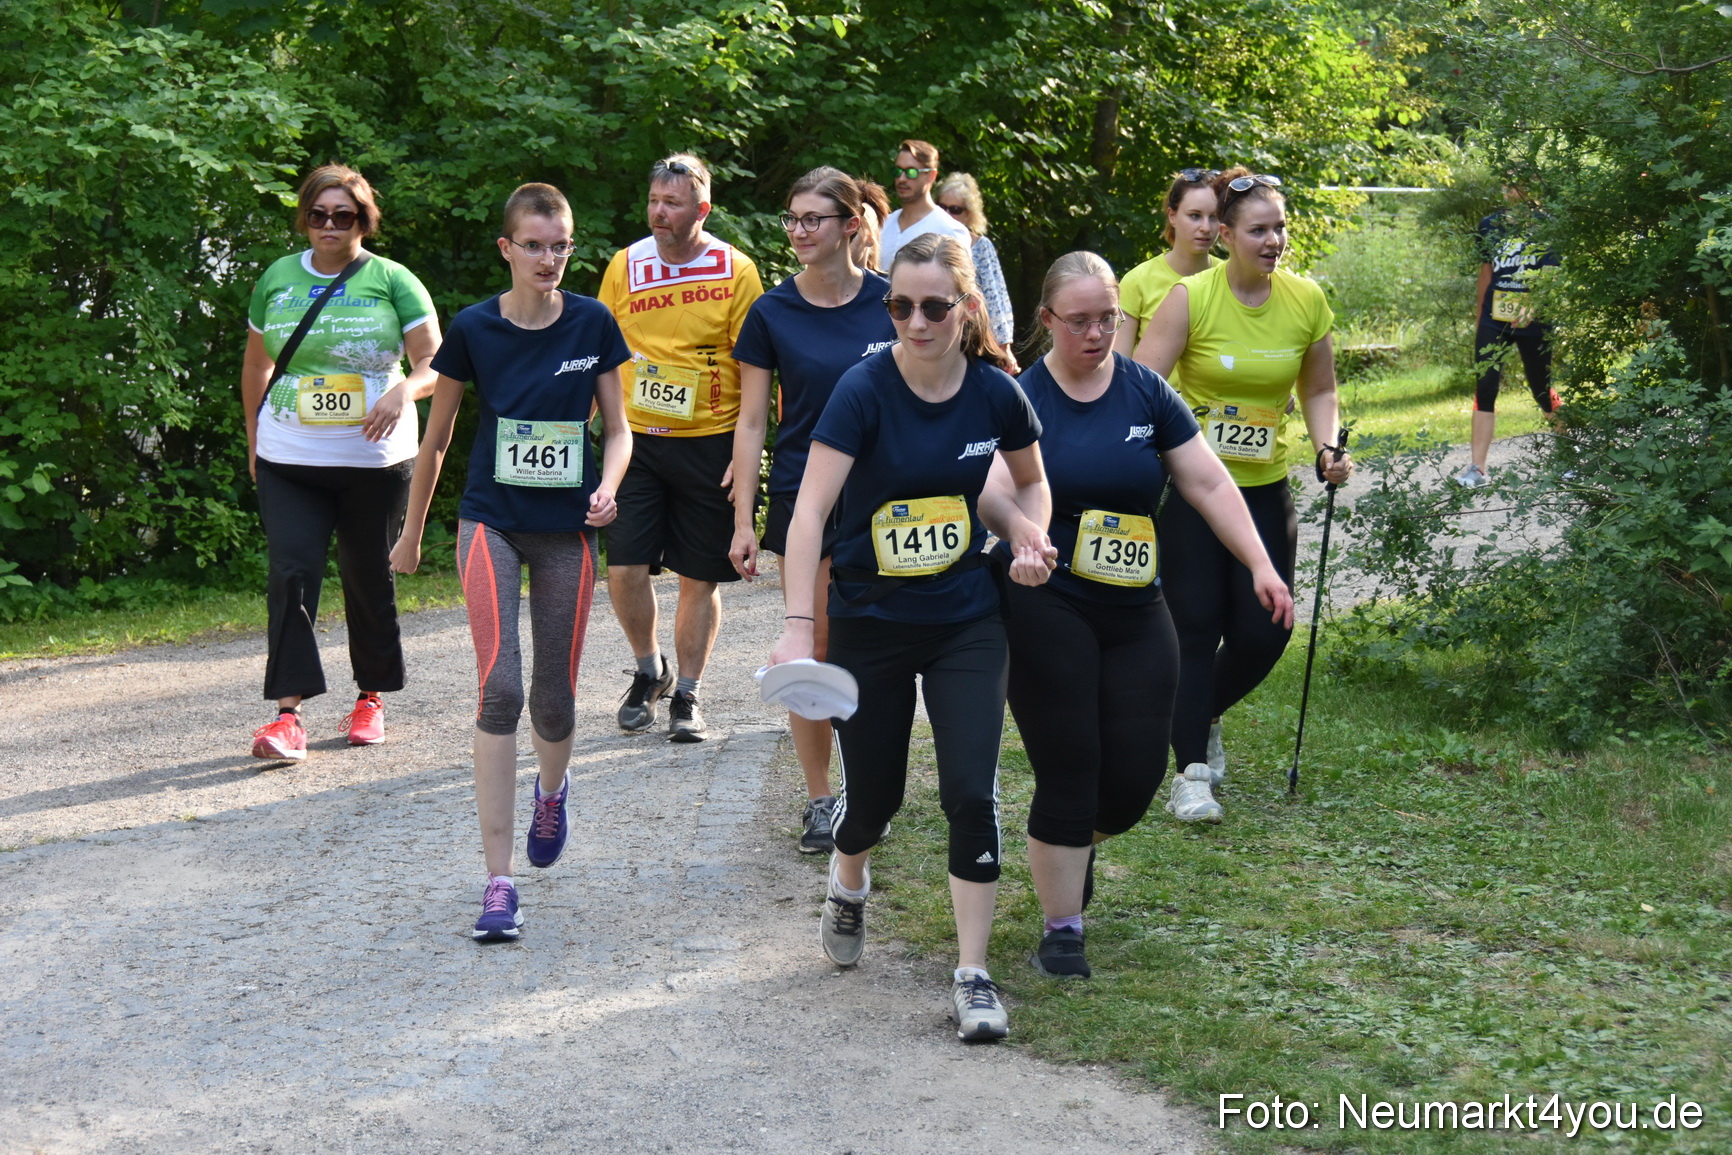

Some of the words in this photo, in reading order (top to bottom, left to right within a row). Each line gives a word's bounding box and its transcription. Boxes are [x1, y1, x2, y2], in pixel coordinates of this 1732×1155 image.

[630, 293, 675, 314] MAX
[681, 285, 734, 304] BÖGL
[264, 321, 300, 332] Gesun
[320, 315, 374, 324] Firmen
[280, 328, 325, 338] laen
[331, 324, 384, 337] länger!
[554, 359, 588, 376] JURA
[640, 379, 686, 405] 1654
[312, 392, 351, 411] 380
[1214, 422, 1268, 448] 1223
[508, 443, 569, 469] 1461
[957, 440, 992, 460] JURA
[516, 468, 536, 476] Willer
[885, 513, 924, 524] firmenlauf
[1094, 523, 1131, 536] firmenlauf
[885, 523, 959, 556] 1416
[898, 555, 918, 564] Lang
[919, 552, 950, 562] Gabriela
[1089, 536, 1150, 568] 1396
[922, 560, 946, 568] Neumarkt
[1087, 568, 1116, 577] Lebenshilfe
[1095, 562, 1124, 573] Gottlieb
[1124, 567, 1140, 575] Marie
